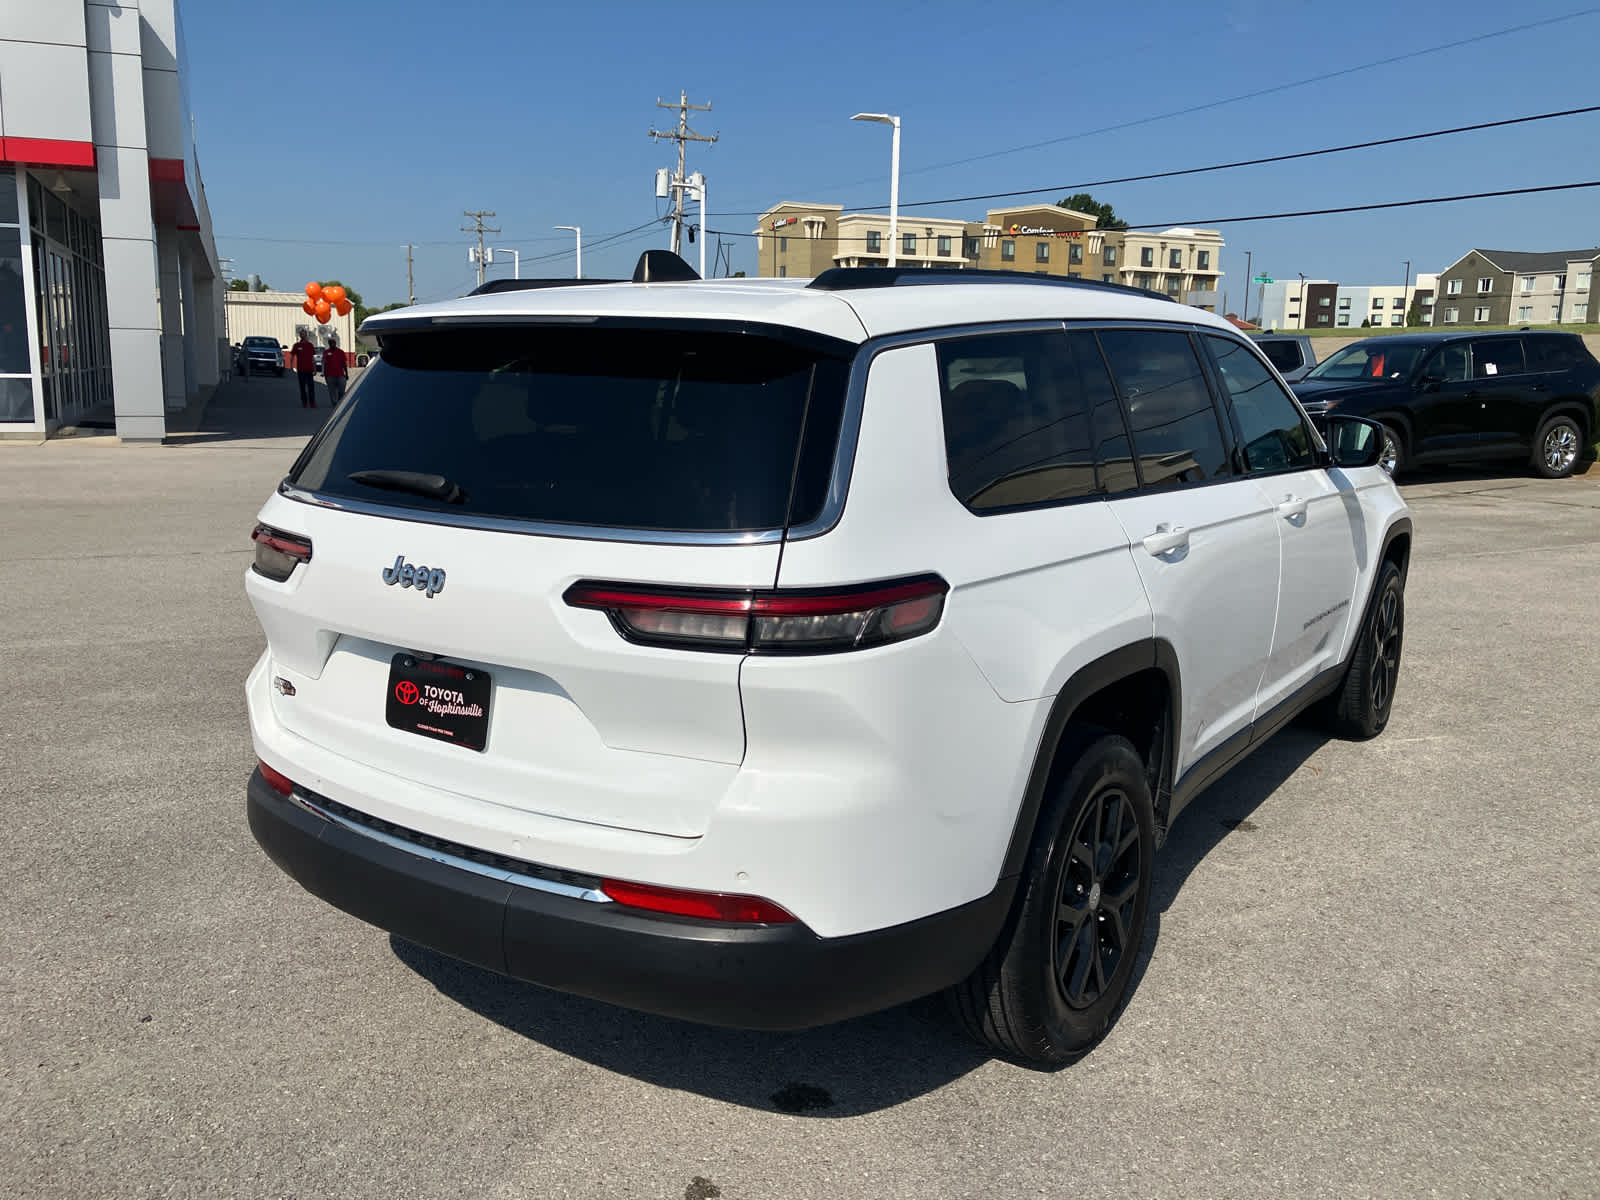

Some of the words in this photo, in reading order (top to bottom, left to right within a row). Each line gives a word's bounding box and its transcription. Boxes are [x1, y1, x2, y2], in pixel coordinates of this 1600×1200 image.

[382, 555, 446, 599] Jeep
[424, 685, 464, 705] TOYOTA
[419, 697, 430, 706] OF
[427, 700, 483, 717] Hopkinsville
